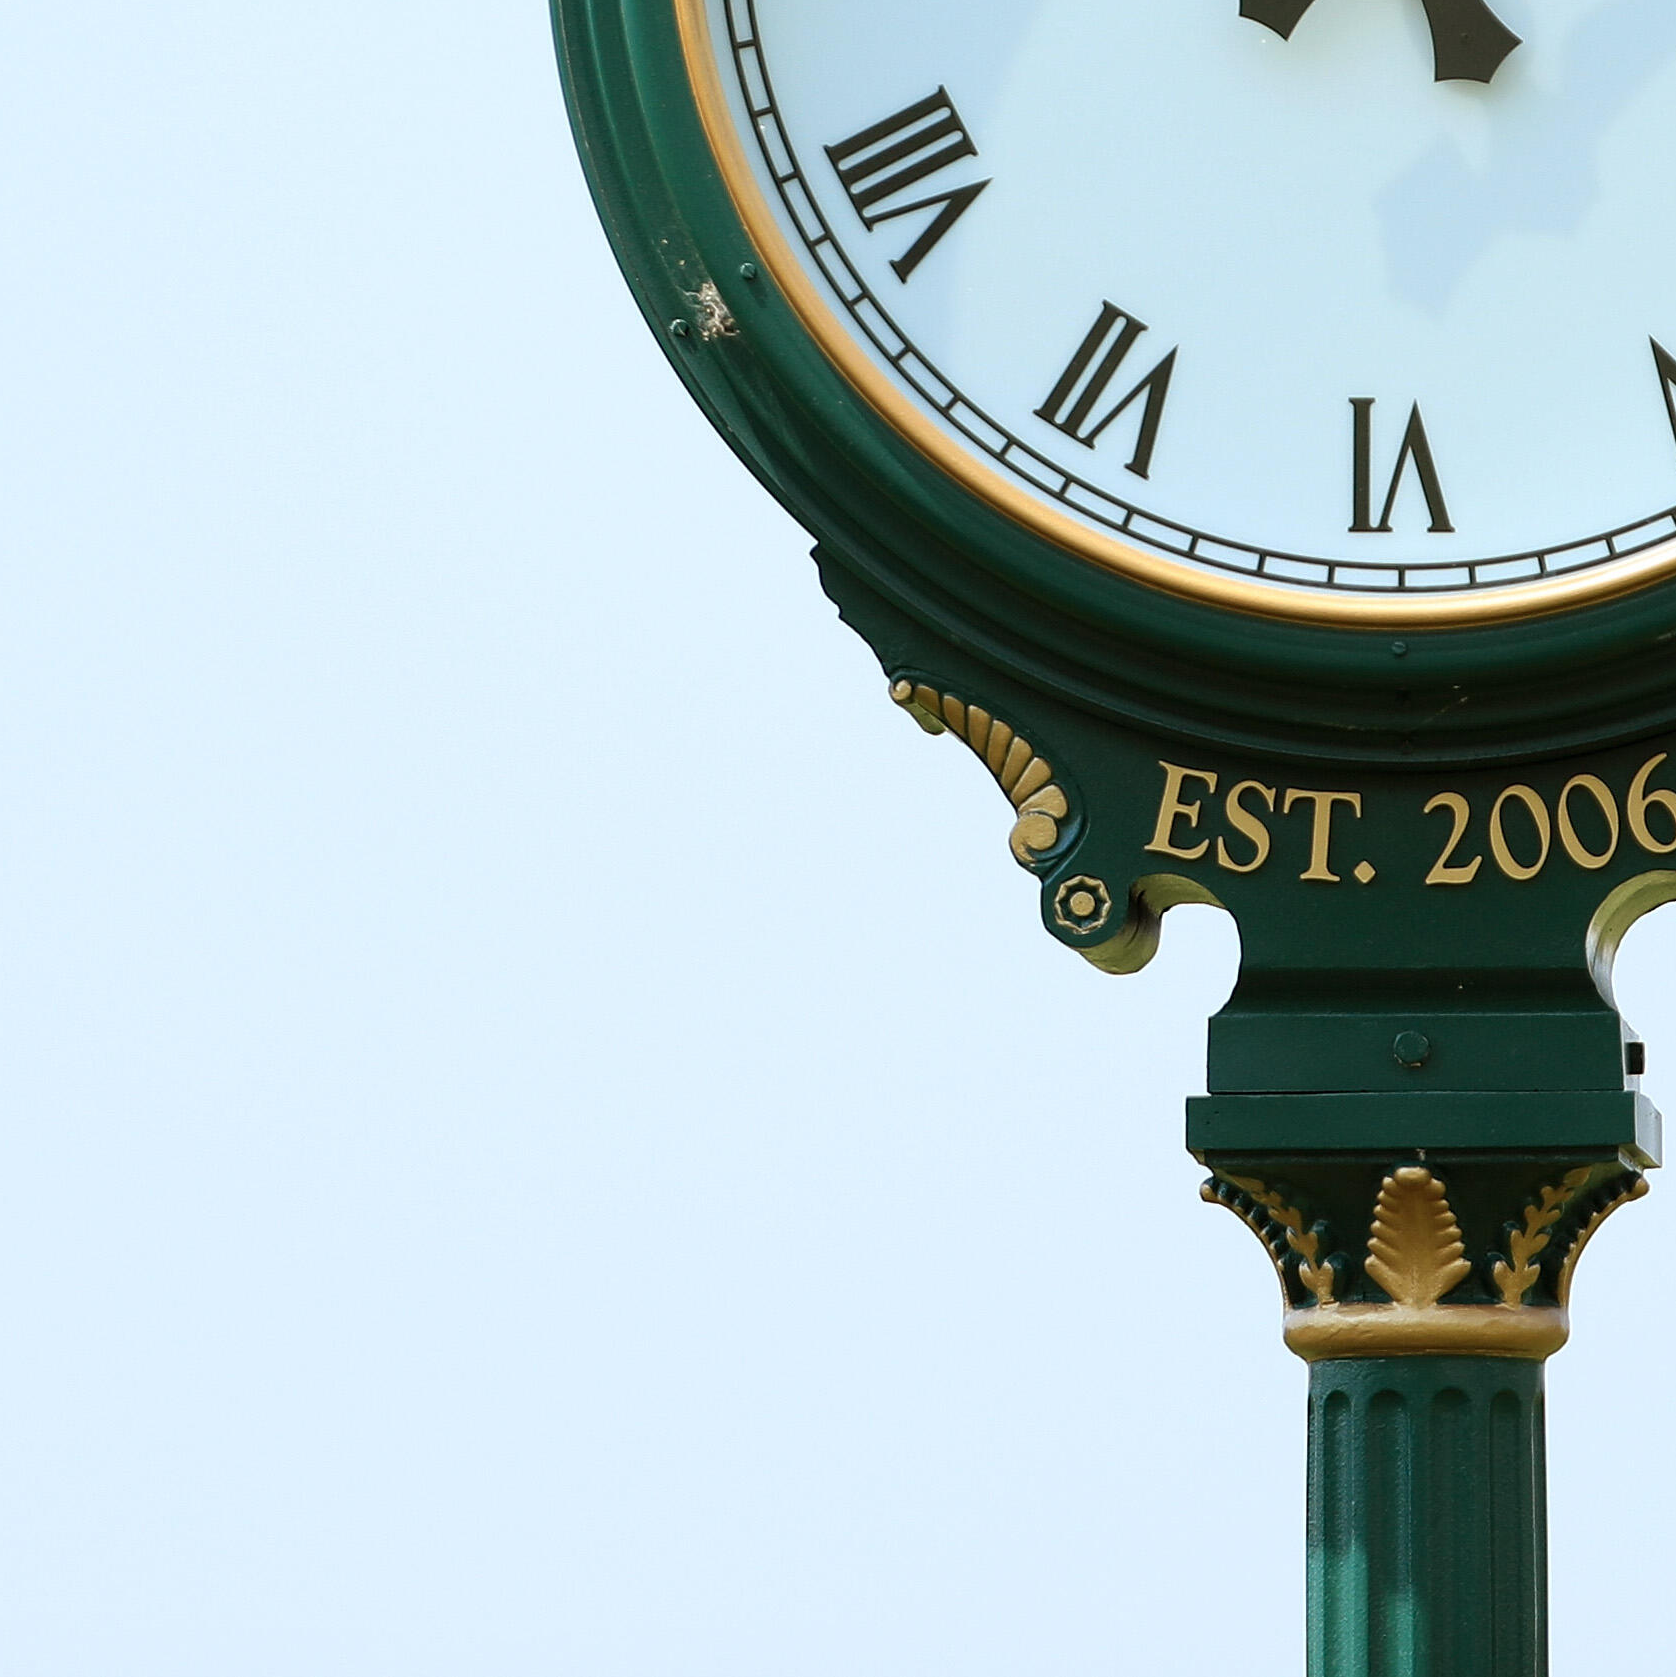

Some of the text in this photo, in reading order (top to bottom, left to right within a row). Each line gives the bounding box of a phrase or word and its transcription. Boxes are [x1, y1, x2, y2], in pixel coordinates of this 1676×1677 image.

[824, 86, 992, 284] VIII
[1033, 299, 1178, 480] VII
[1349, 398, 1454, 533] VI
[1144, 760, 1377, 884] EST.
